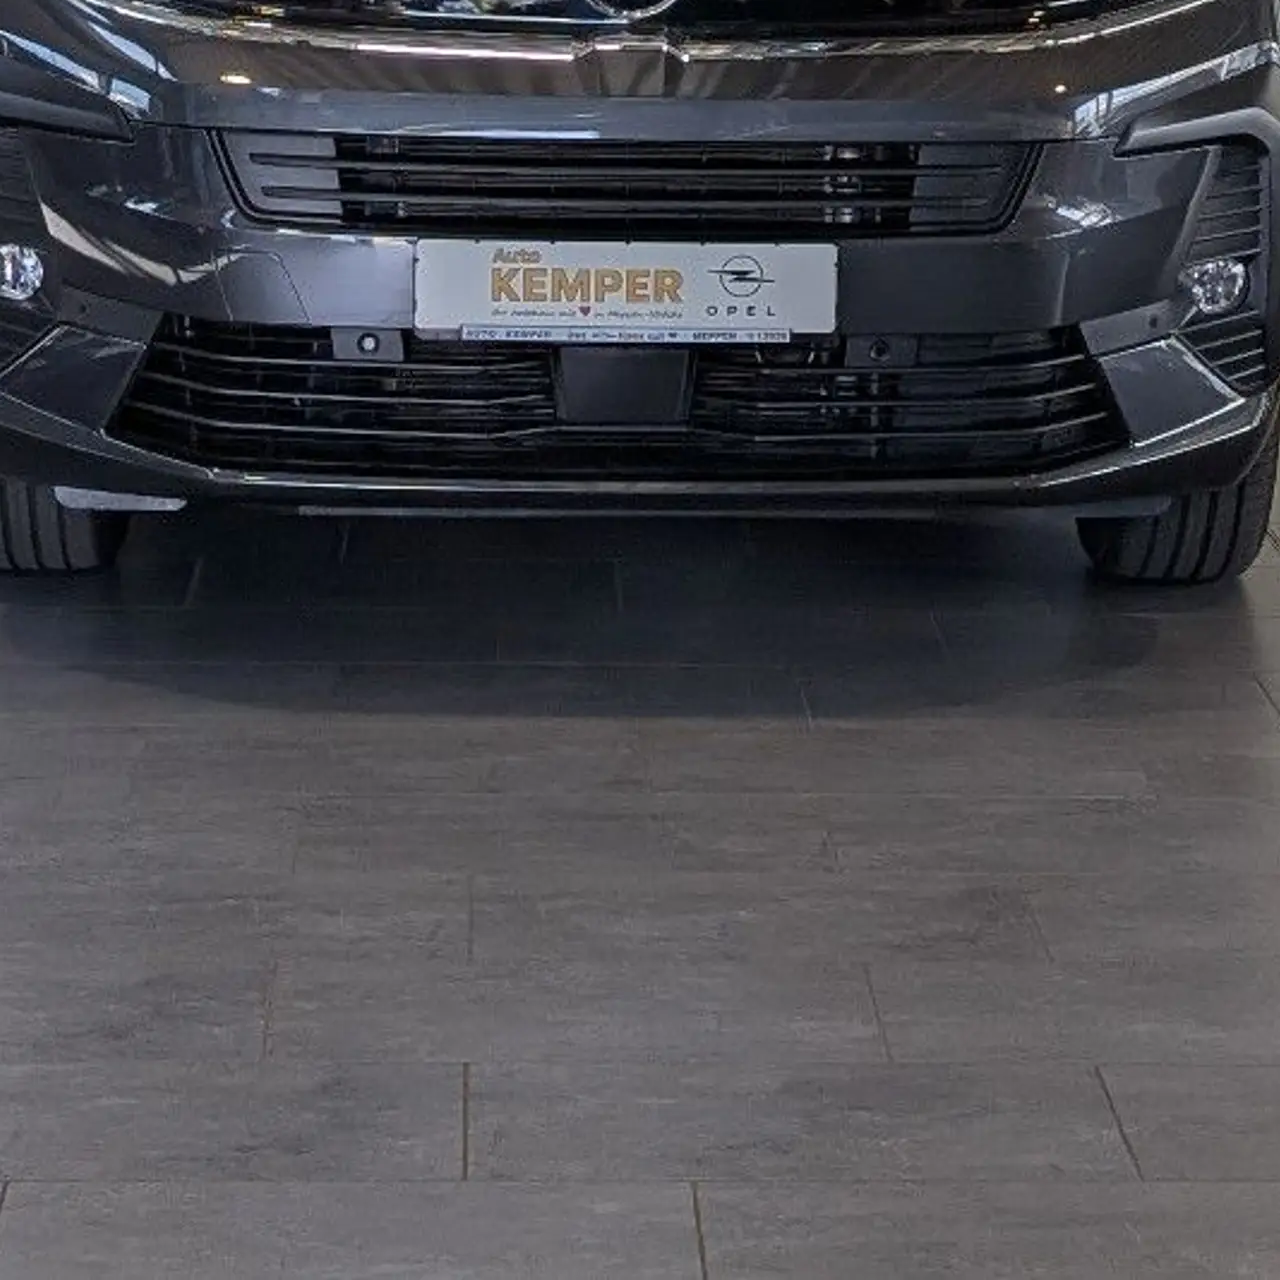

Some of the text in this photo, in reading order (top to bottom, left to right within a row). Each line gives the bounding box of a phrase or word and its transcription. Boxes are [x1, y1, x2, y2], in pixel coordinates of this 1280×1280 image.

[492, 248, 540, 263] Auto
[491, 267, 684, 303] KEMPER
[706, 306, 776, 317] OPEL
